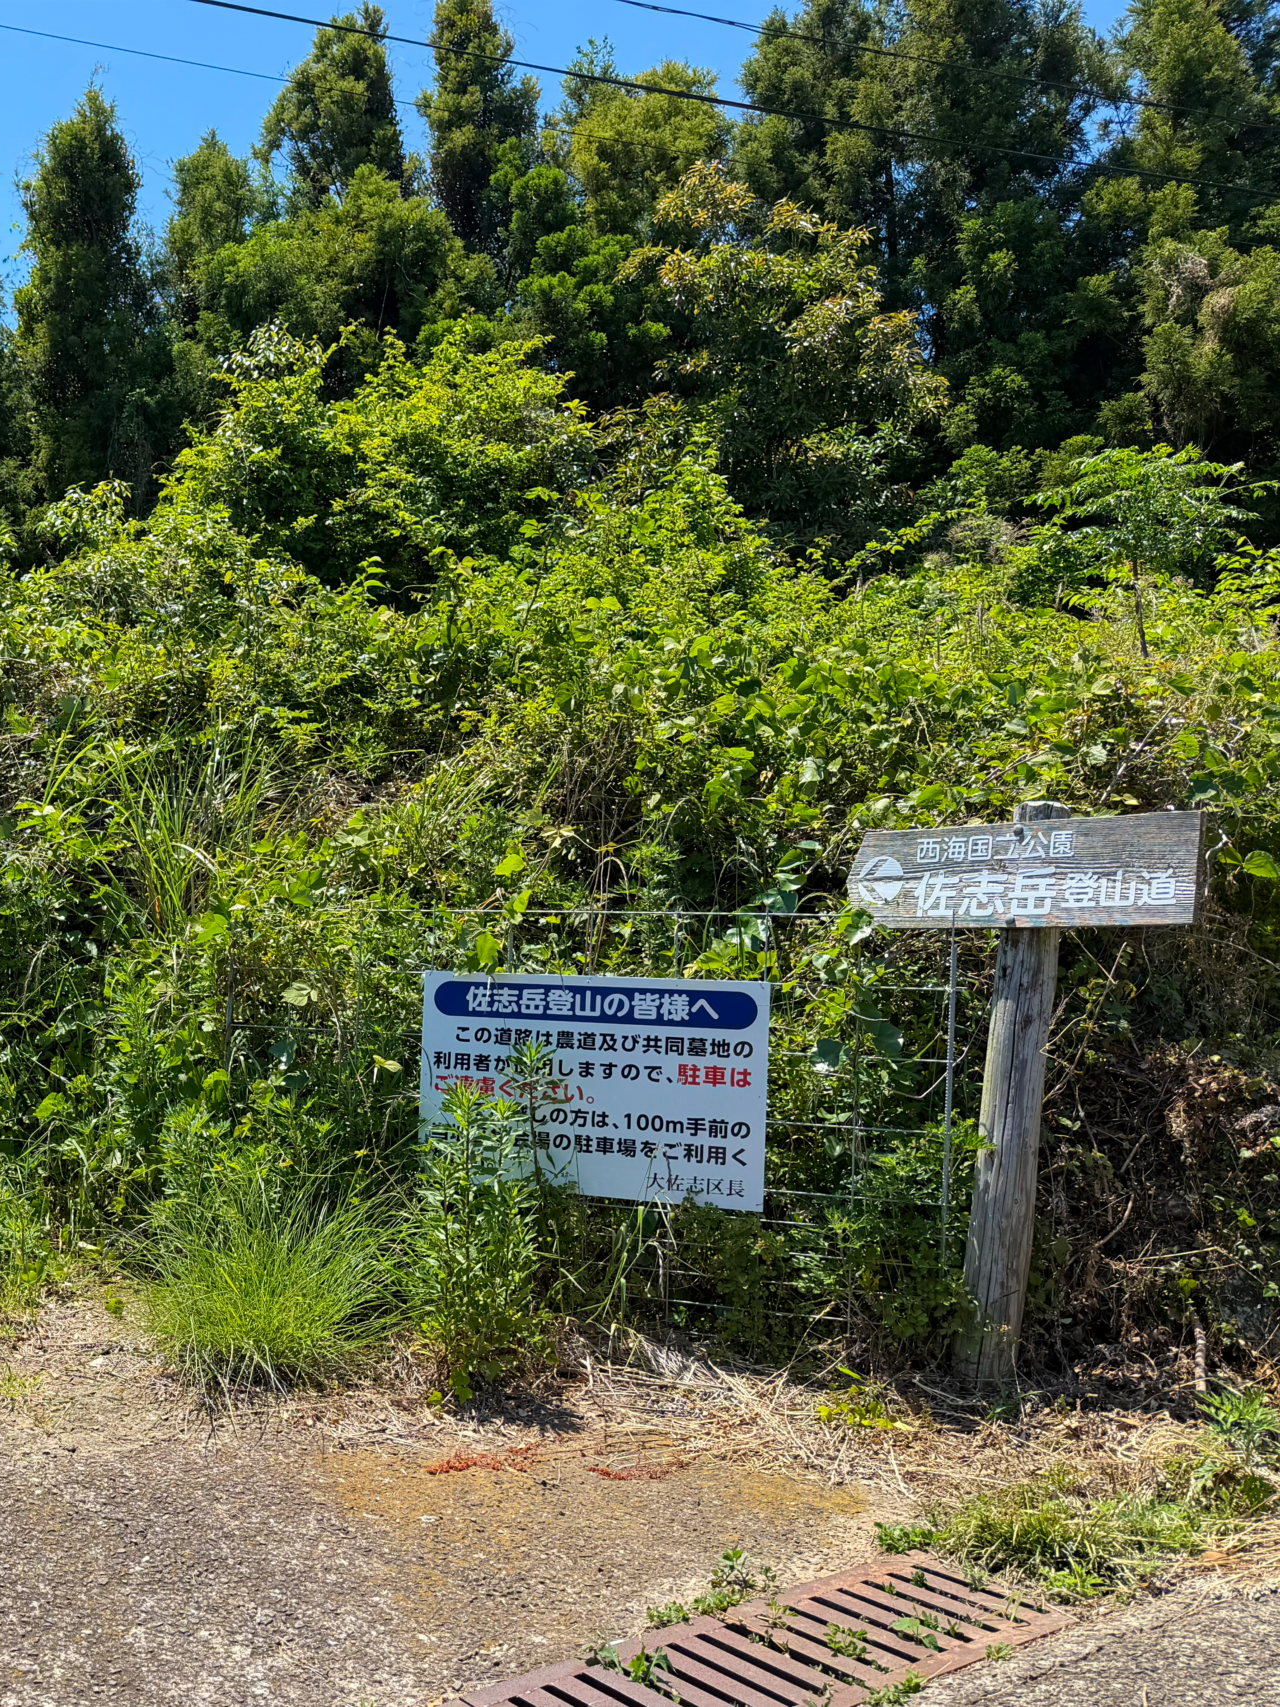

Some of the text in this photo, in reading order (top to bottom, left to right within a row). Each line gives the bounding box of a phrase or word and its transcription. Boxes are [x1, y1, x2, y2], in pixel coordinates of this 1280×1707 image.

[917, 830, 1075, 863] 西海国立公園
[914, 866, 1178, 917] 佐志岳登山道
[466, 986, 720, 1021] 佐志岳登山の皆様へ
[455, 1026, 754, 1059] この道路は農道及び共同墓地の
[433, 1051, 752, 1088] 利用者が用しますので、駐車は
[647, 1172, 745, 1198] 大佐志区長
